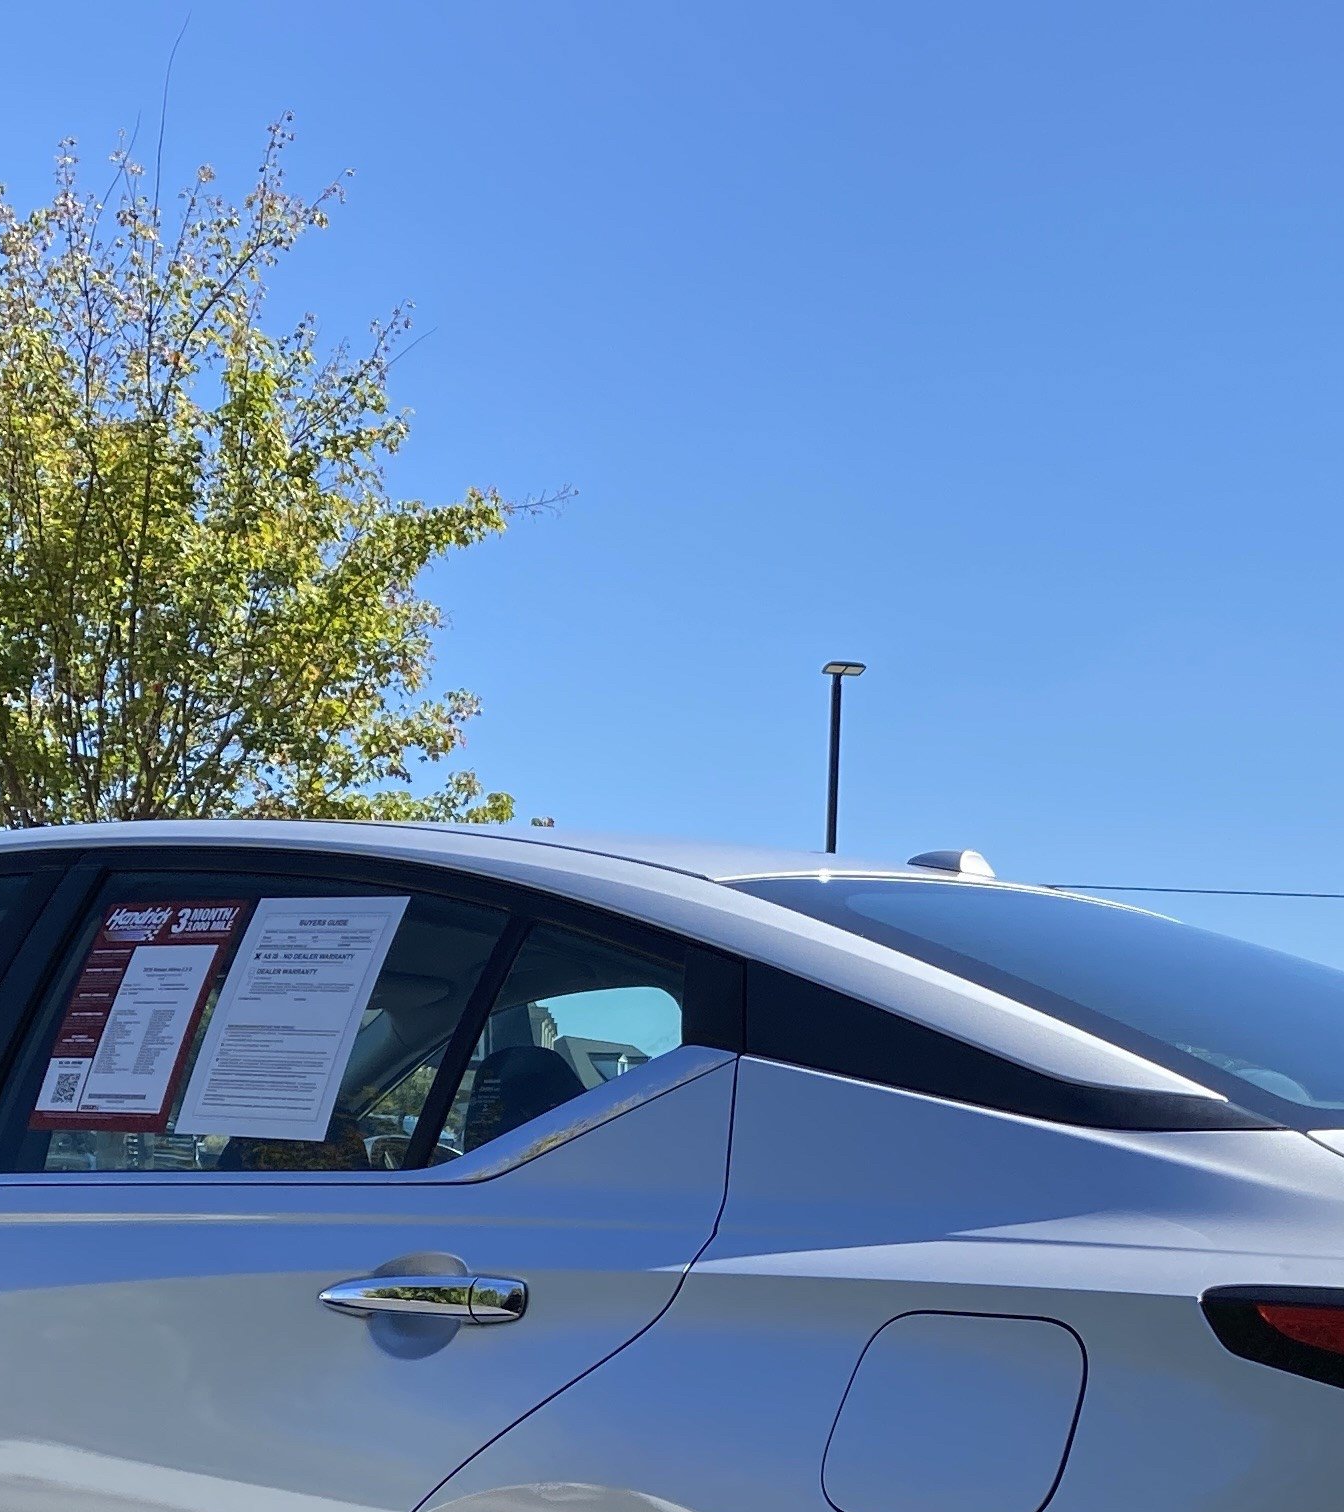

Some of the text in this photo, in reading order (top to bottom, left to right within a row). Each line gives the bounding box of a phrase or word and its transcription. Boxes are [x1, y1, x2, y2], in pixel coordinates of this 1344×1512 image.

[105, 906, 173, 931] Hendrick
[170, 906, 240, 934] 3 MONTH/
